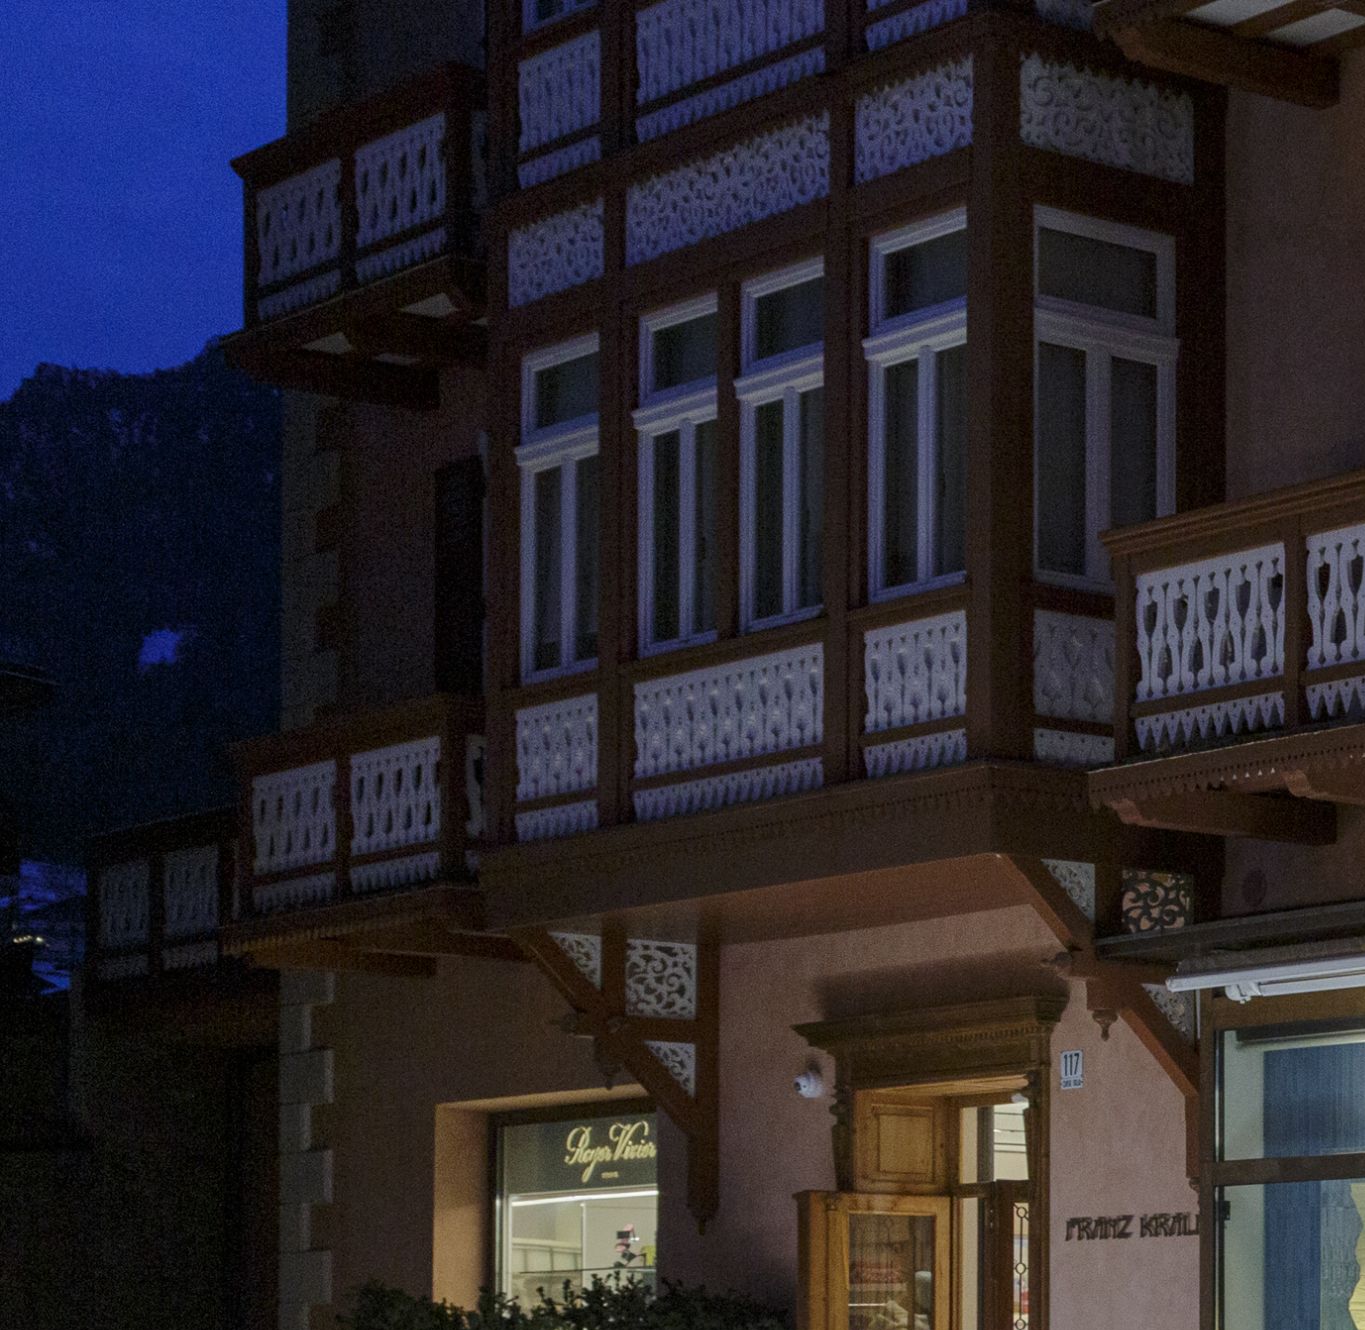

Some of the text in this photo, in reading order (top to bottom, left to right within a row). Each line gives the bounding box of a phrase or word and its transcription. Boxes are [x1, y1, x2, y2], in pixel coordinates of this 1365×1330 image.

[1064, 1053, 1080, 1076] 117
[1064, 1212, 1201, 1242] FRANZ KRAL
